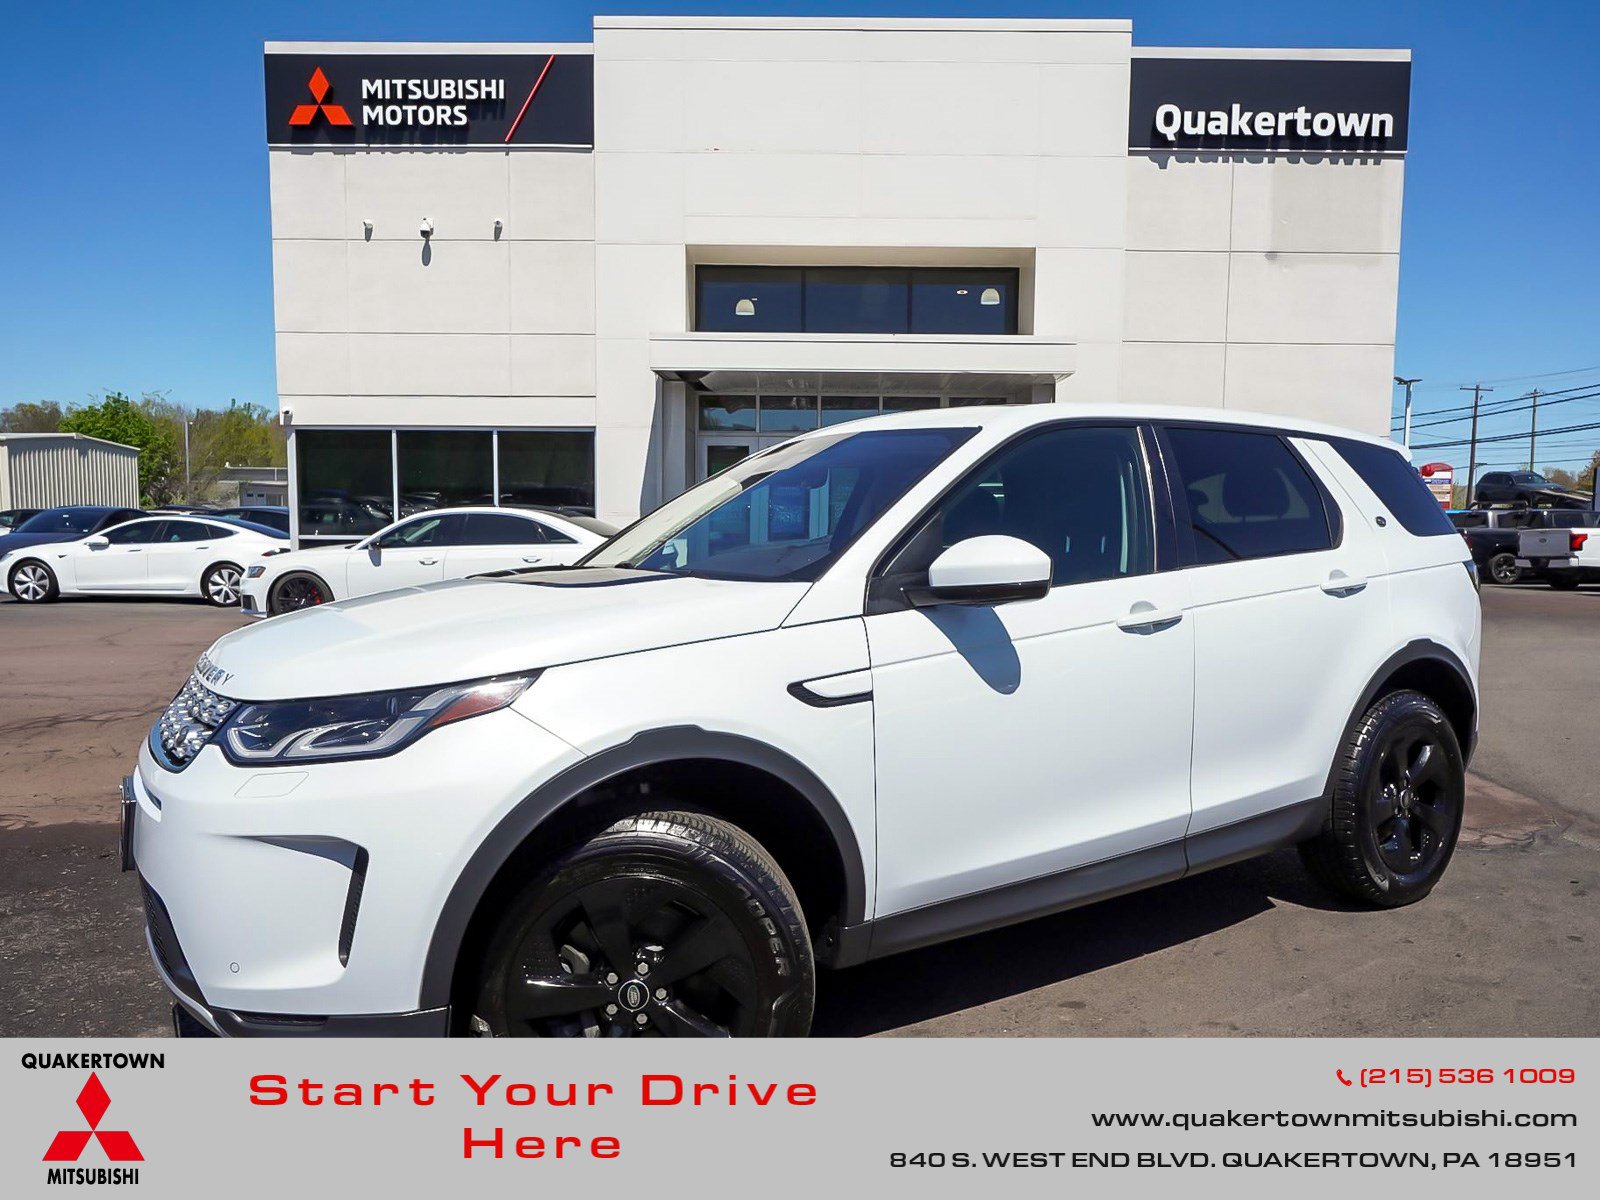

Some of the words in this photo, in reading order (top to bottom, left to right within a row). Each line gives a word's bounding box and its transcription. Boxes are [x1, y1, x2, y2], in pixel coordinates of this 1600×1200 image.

[361, 79, 505, 100] MITSUBISHI
[362, 105, 468, 126] MOTORS
[1155, 103, 1394, 141] Quakertown
